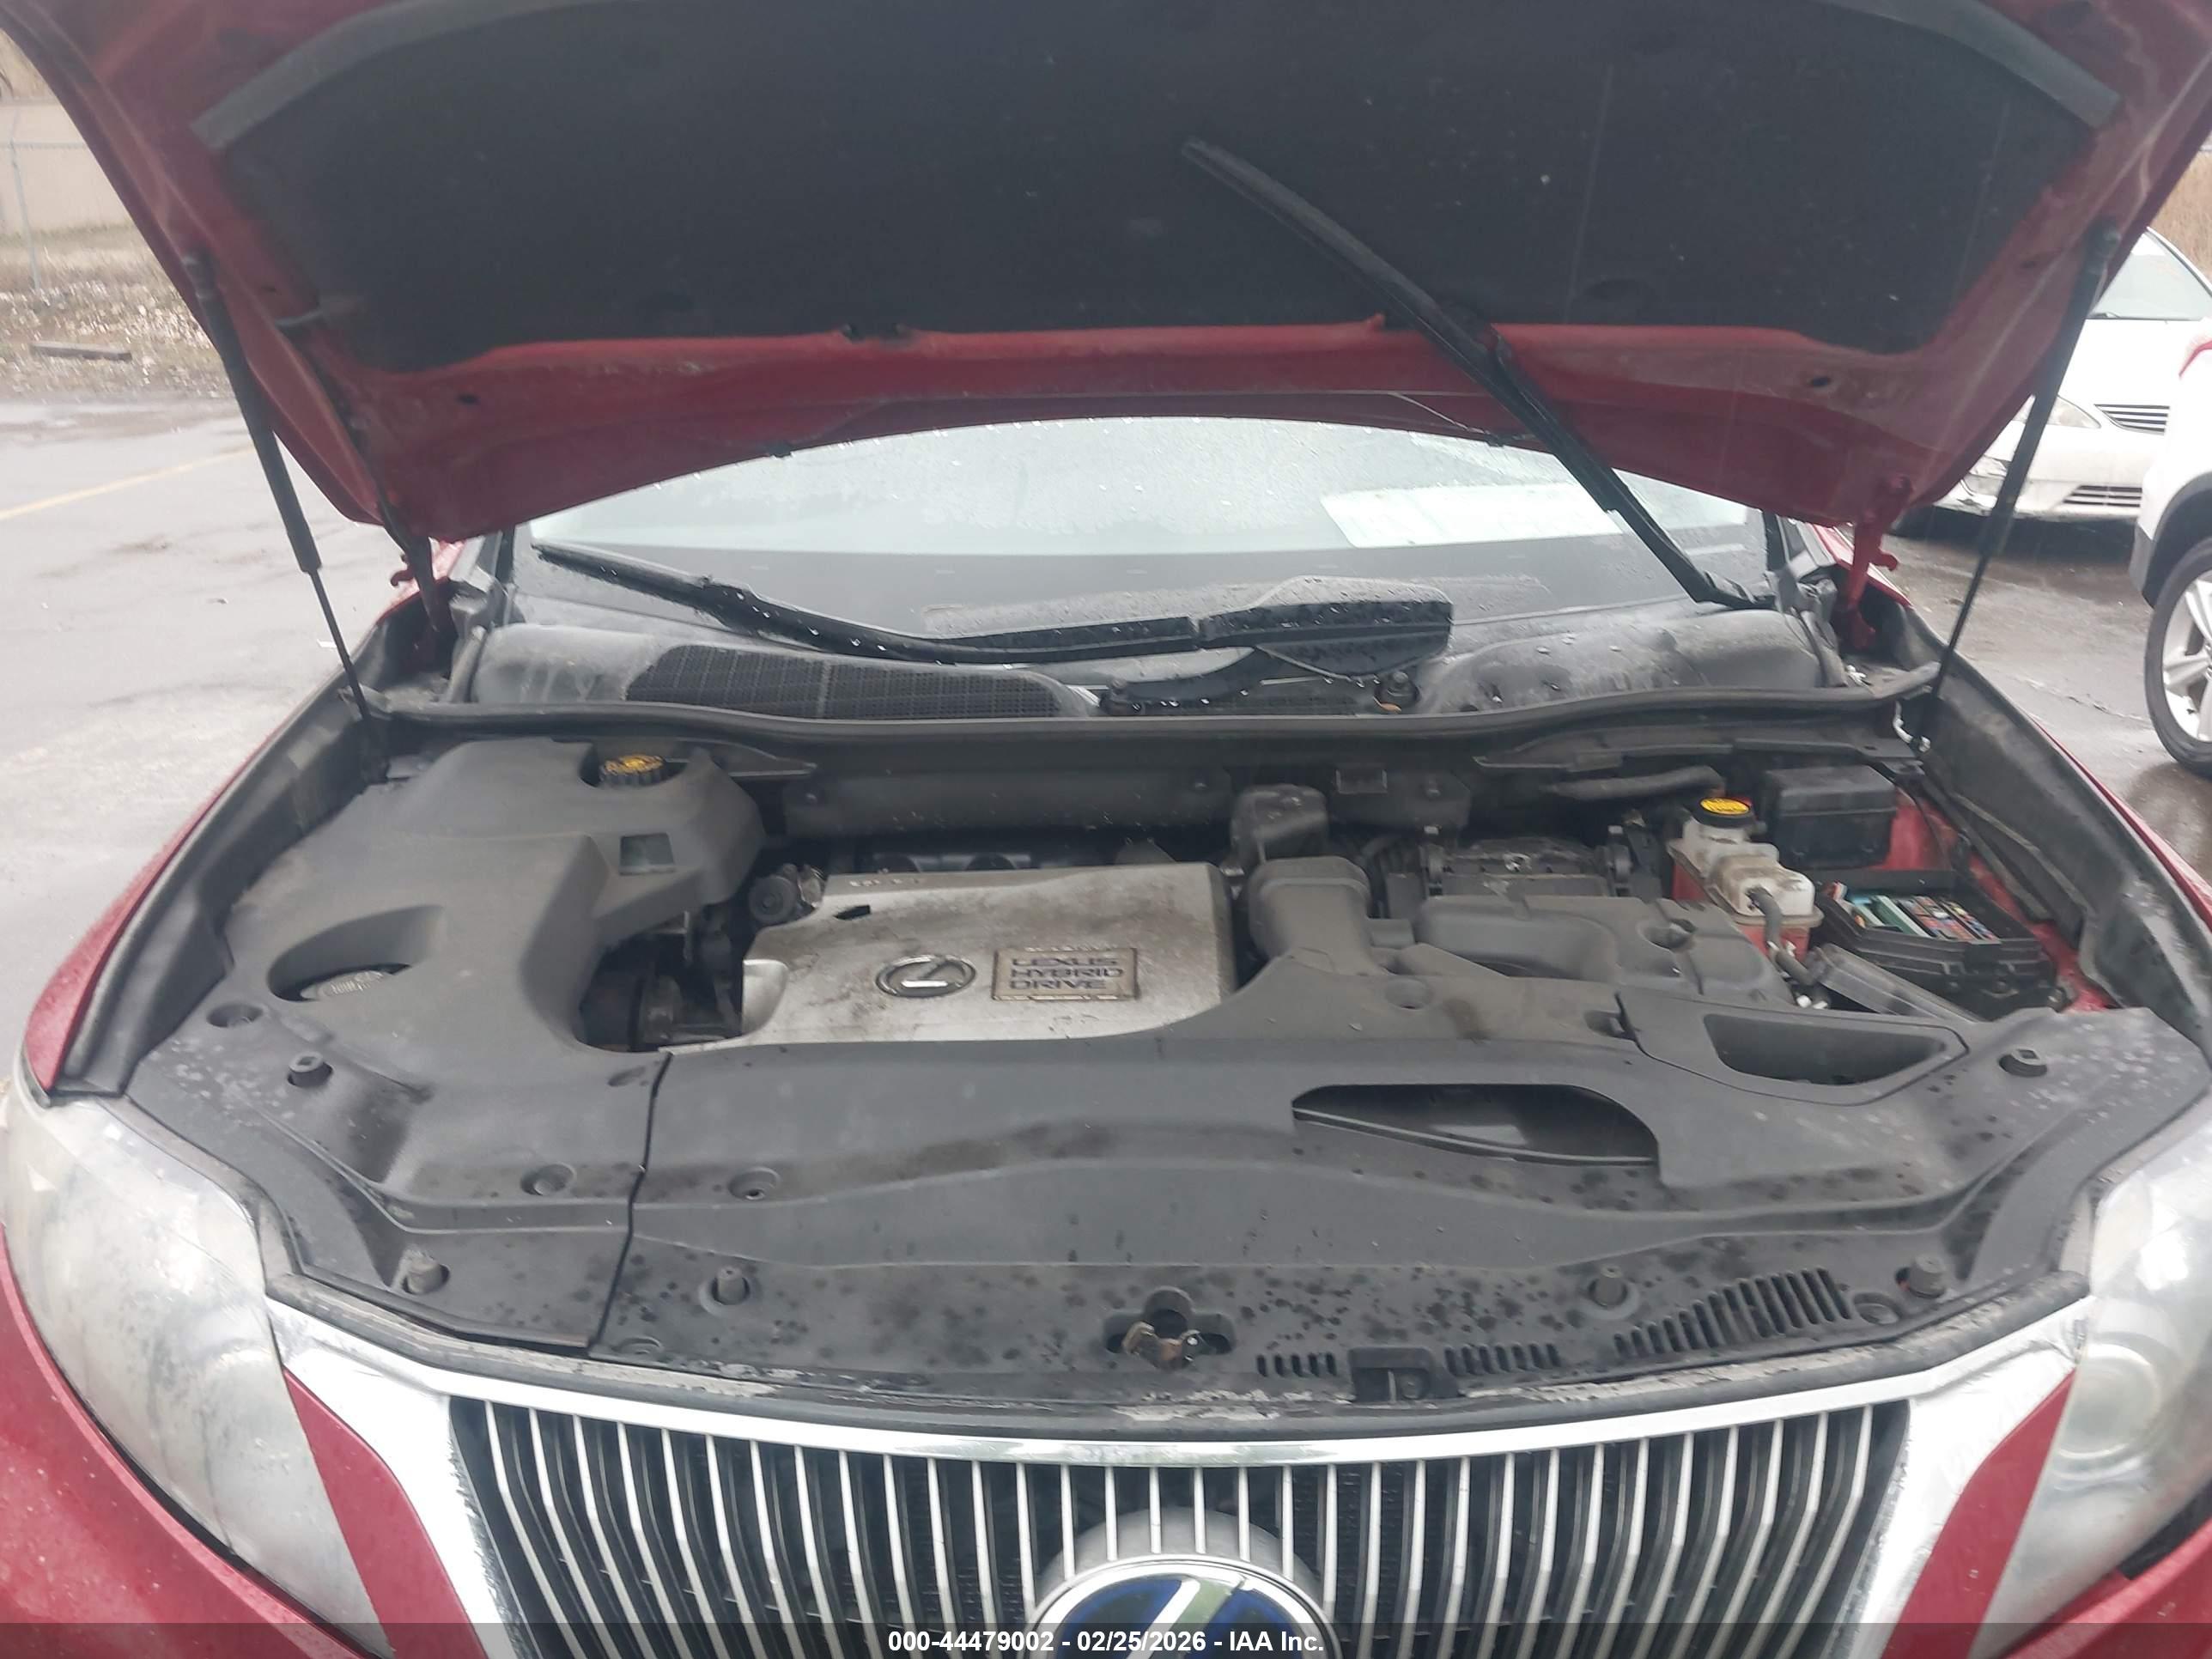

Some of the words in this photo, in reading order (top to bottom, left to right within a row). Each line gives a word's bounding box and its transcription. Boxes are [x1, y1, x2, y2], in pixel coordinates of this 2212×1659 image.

[1012, 957, 1118, 967] LEXUS
[1011, 968, 1124, 978] HYBRID
[1009, 980, 1107, 989] DRIVE
